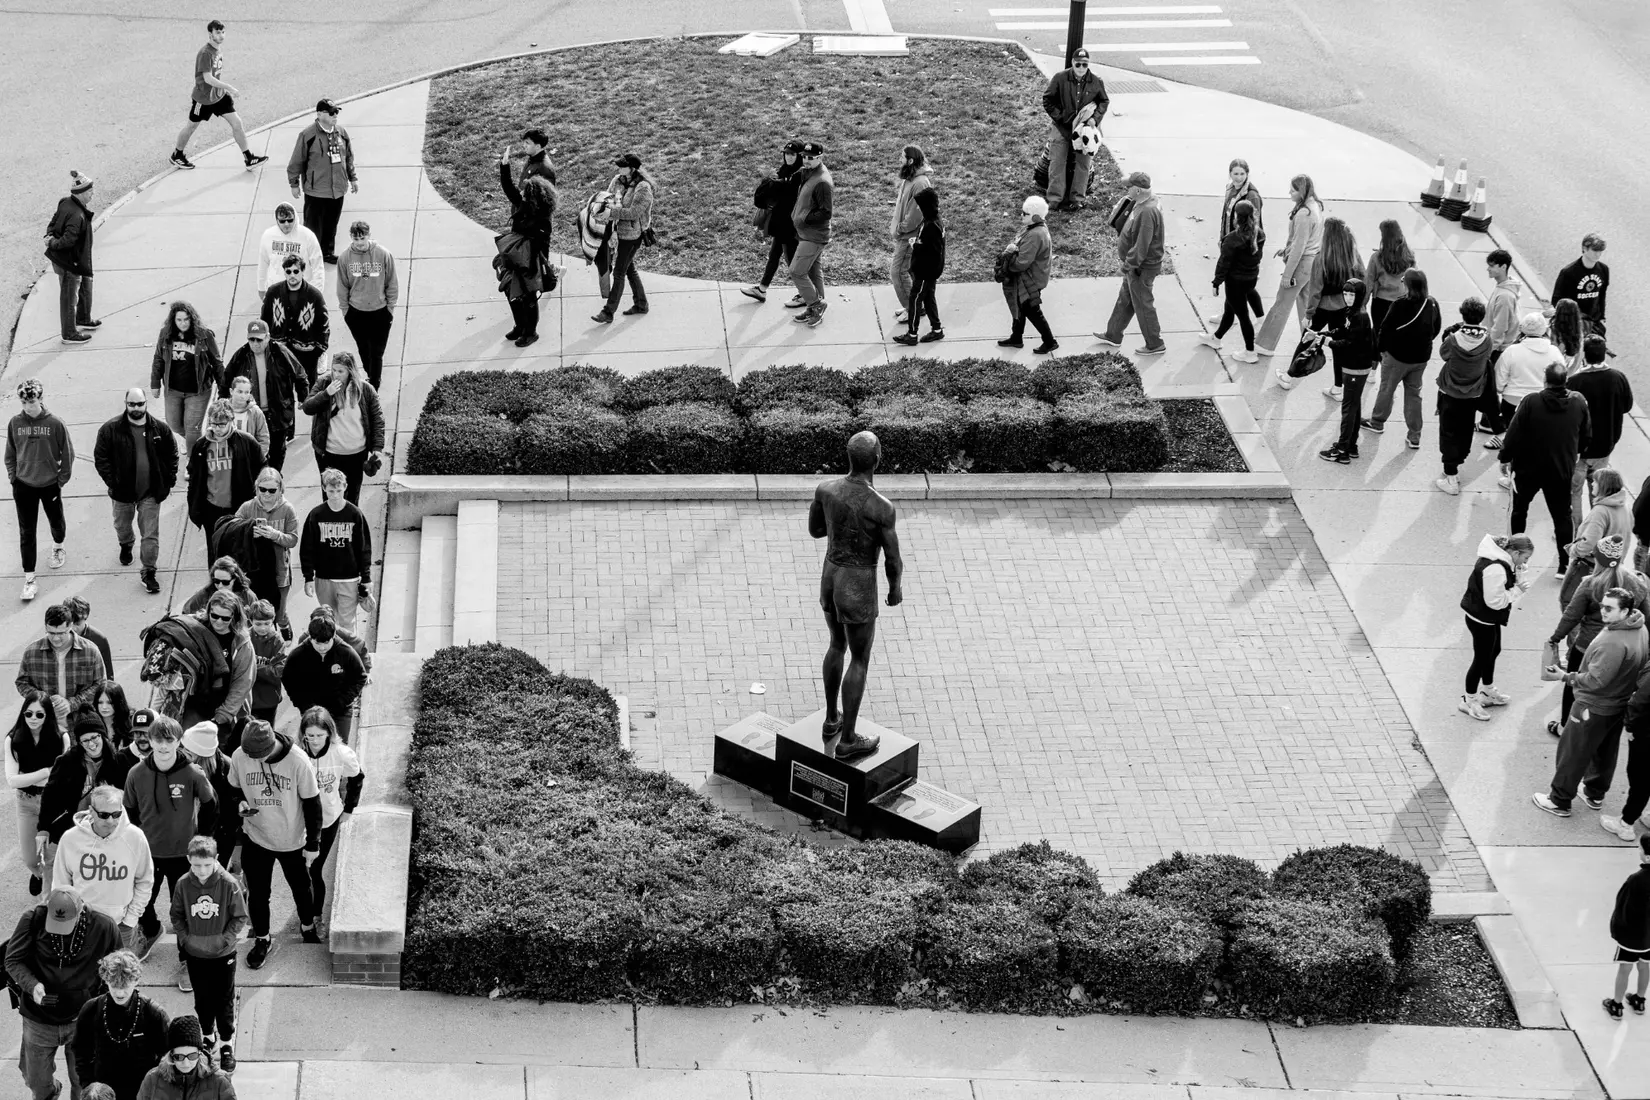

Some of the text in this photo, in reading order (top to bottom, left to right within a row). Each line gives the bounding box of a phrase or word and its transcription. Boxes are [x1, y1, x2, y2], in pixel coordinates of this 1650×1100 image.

[285, 241, 301, 254] STATE
[1577, 273, 1602, 289] OHIO STATE
[1577, 291, 1600, 299] SOCCER
[172, 350, 187, 361] M
[17, 426, 51, 436] OHIO STATE
[318, 521, 356, 543] MICHIGAN
[329, 537, 346, 548] M
[245, 771, 264, 786] OHIO
[80, 853, 129, 881] Ohio
